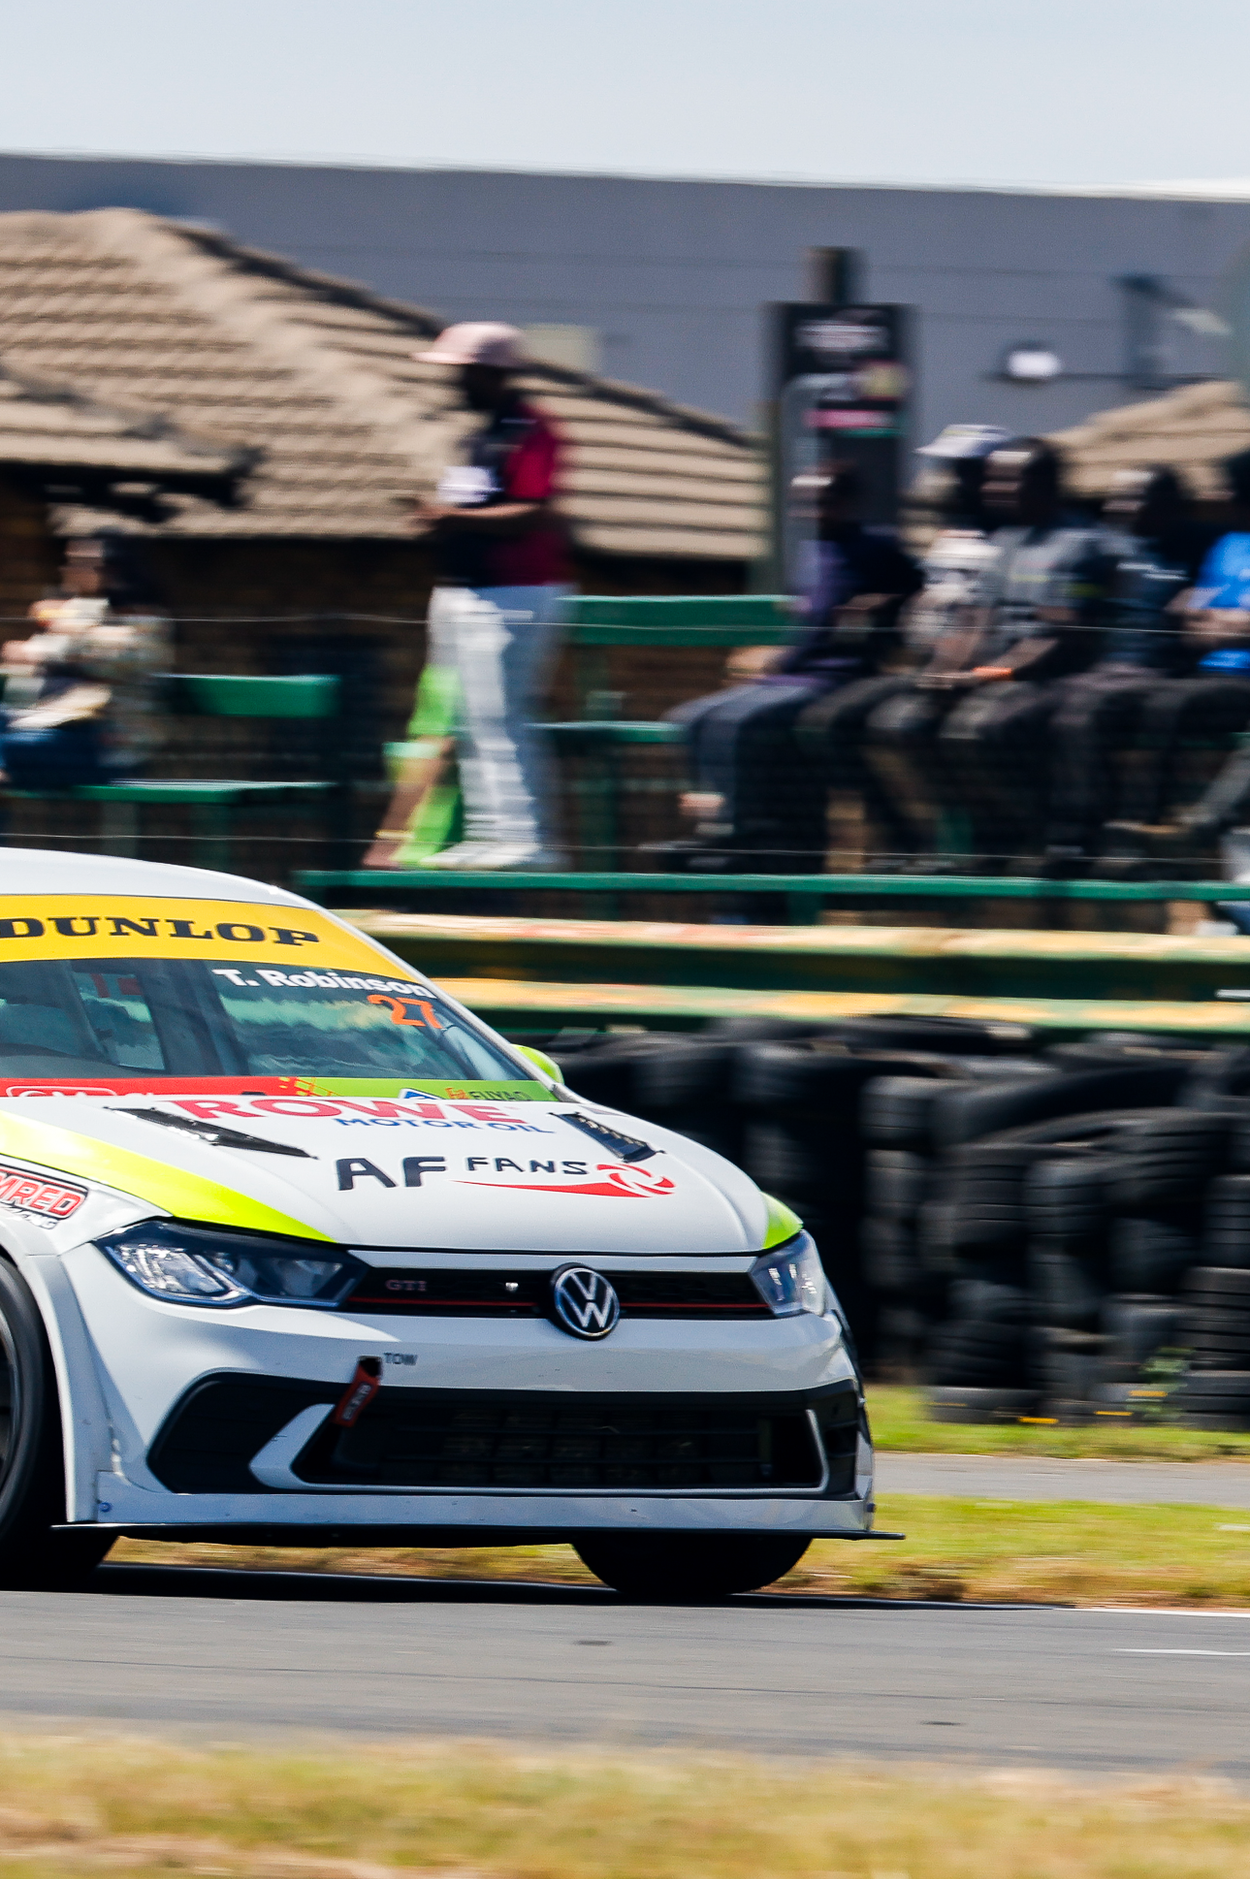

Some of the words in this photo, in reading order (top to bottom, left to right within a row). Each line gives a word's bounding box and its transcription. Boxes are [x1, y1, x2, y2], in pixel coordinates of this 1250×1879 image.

[212, 968, 261, 987] T.
[256, 969, 438, 999] Robinson
[366, 994, 444, 1030] 27
[170, 1099, 528, 1124] ROWE
[334, 1117, 483, 1130] MOTOR
[486, 1122, 554, 1134] OIL
[335, 1156, 447, 1191] AF
[466, 1156, 590, 1176] FANS
[385, 1279, 428, 1292] GTI
[383, 1351, 418, 1367] TOW
